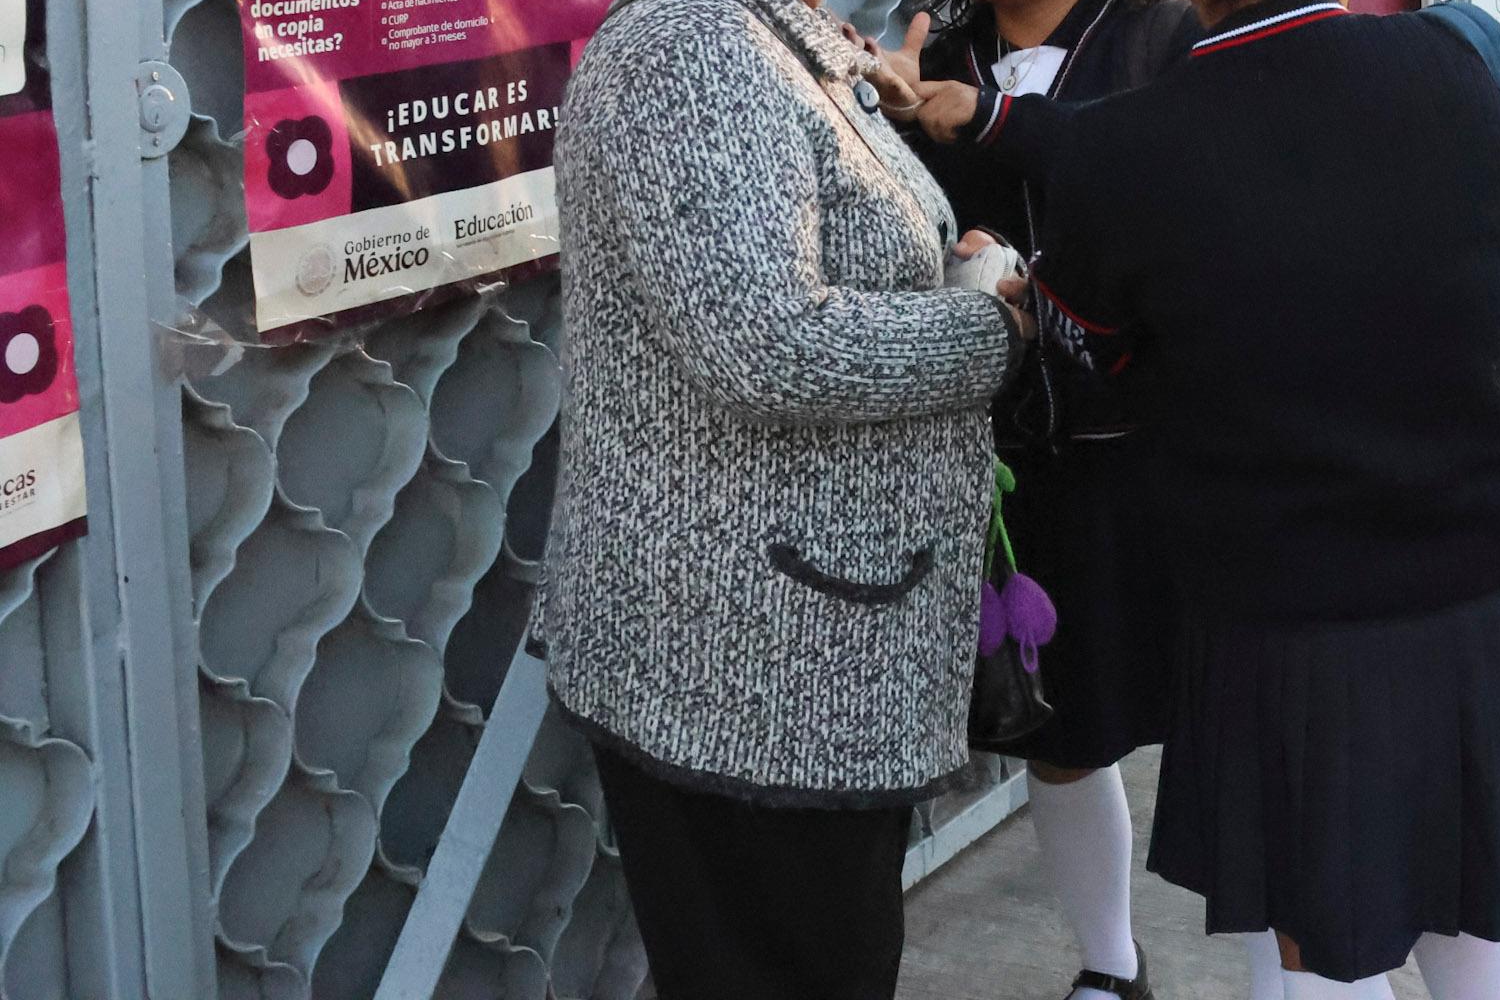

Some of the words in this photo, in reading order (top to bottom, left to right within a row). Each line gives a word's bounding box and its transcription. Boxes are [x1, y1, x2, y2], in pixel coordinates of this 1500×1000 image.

[387, 0, 404, 11] Acta
[388, 13, 409, 26] CURP
[277, 14, 324, 40] copia
[388, 23, 440, 40] Comprobante
[441, 20, 453, 31] de
[454, 15, 489, 29] domicilio
[388, 41, 400, 51] no
[401, 36, 423, 50] mayor
[424, 37, 430, 45] a
[431, 33, 437, 44] 3
[438, 31, 467, 43] meses
[257, 33, 344, 62] necesitas?
[387, 86, 500, 133] ¡EDUCAR
[507, 79, 528, 105] ES
[370, 106, 560, 167] TRANSFORMAR!
[454, 201, 534, 240] Educación
[344, 230, 412, 257] Gobierno
[415, 225, 431, 241] de
[343, 246, 430, 284] México
[0, 468, 36, 498] cas
